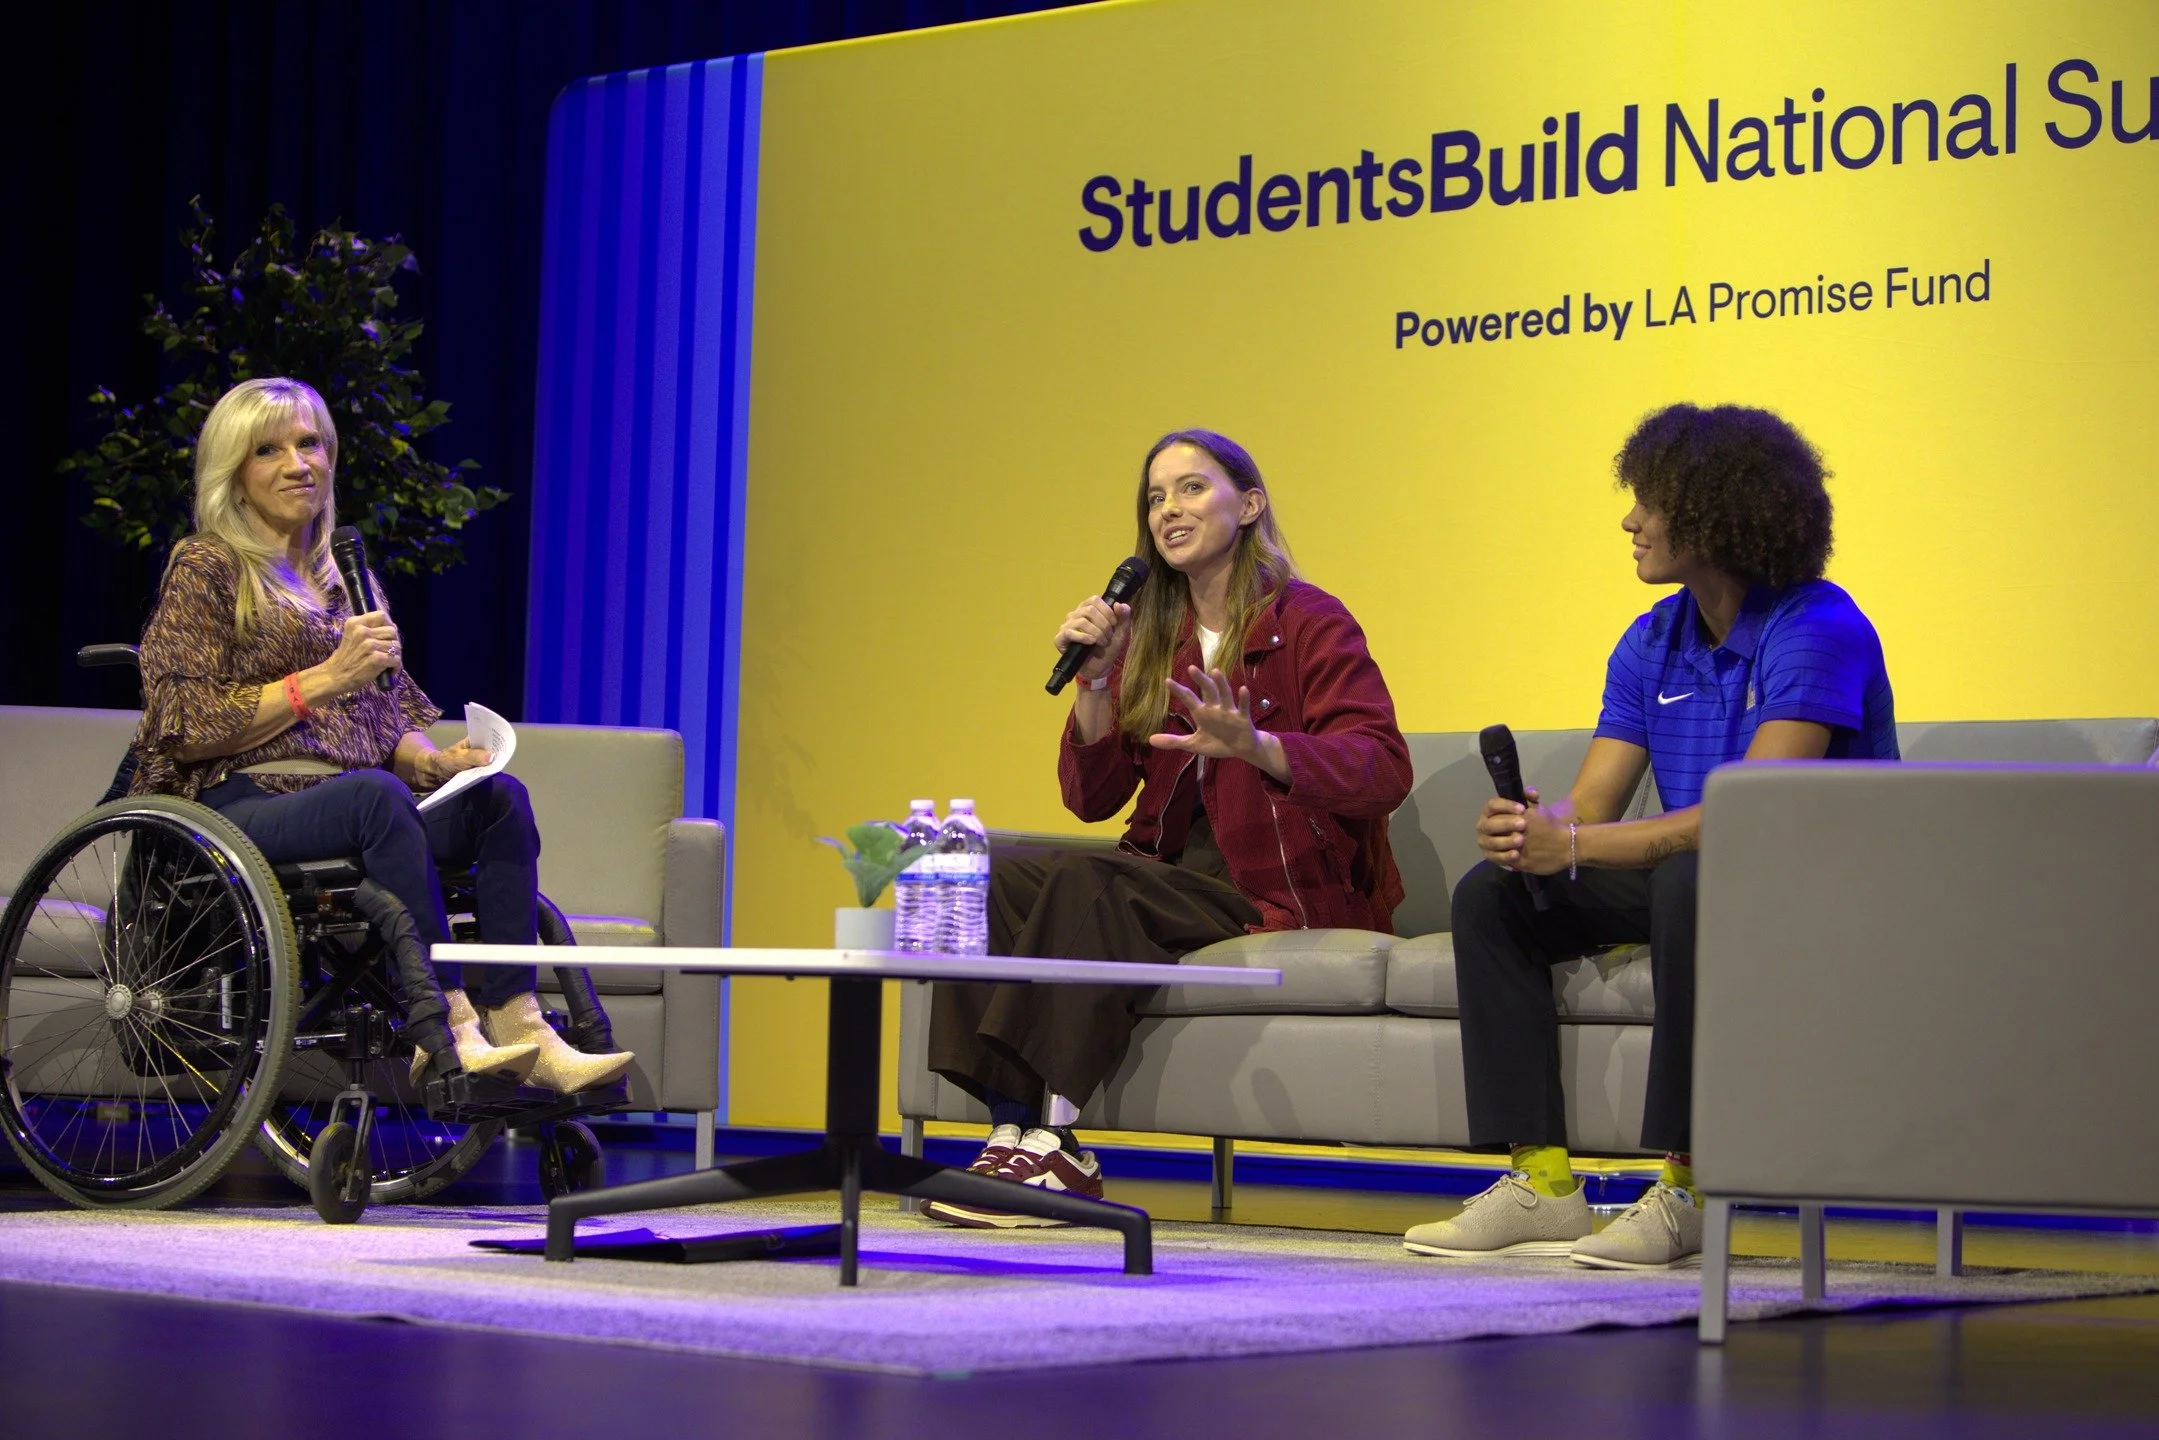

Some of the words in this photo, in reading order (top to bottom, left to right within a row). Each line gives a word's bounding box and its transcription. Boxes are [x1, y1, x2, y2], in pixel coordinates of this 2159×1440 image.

[1078, 104, 1639, 253] StudentsBuild
[1665, 62, 2017, 187] National
[2044, 58, 2159, 150] Su
[1395, 294, 1571, 350] Powered
[1583, 292, 1633, 341] by
[1645, 285, 1697, 328] LA
[1709, 273, 1873, 322] Promise
[1886, 258, 1990, 309] Fund
